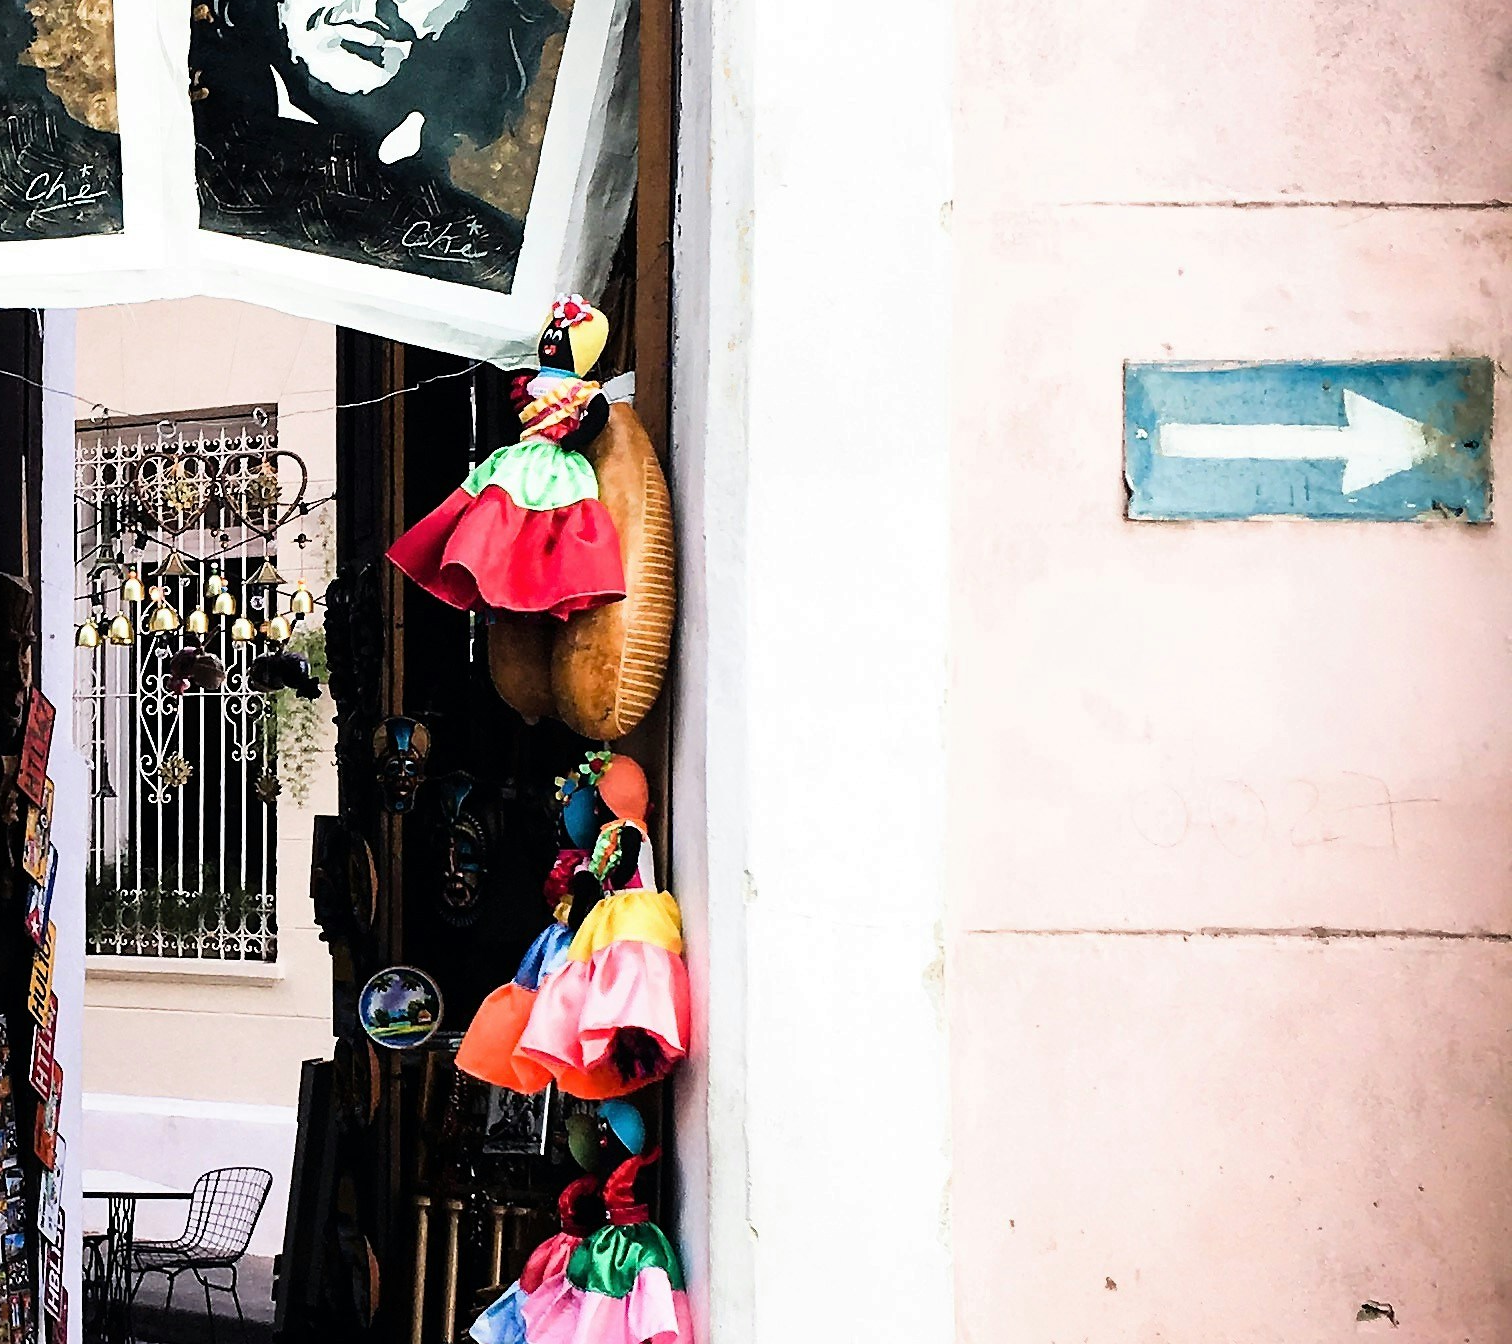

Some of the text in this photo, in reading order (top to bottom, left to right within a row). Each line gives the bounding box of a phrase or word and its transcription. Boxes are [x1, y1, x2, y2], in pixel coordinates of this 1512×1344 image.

[25, 168, 108, 203] Che
[401, 219, 488, 259] Che
[47, 1211, 63, 1313] HBL1
